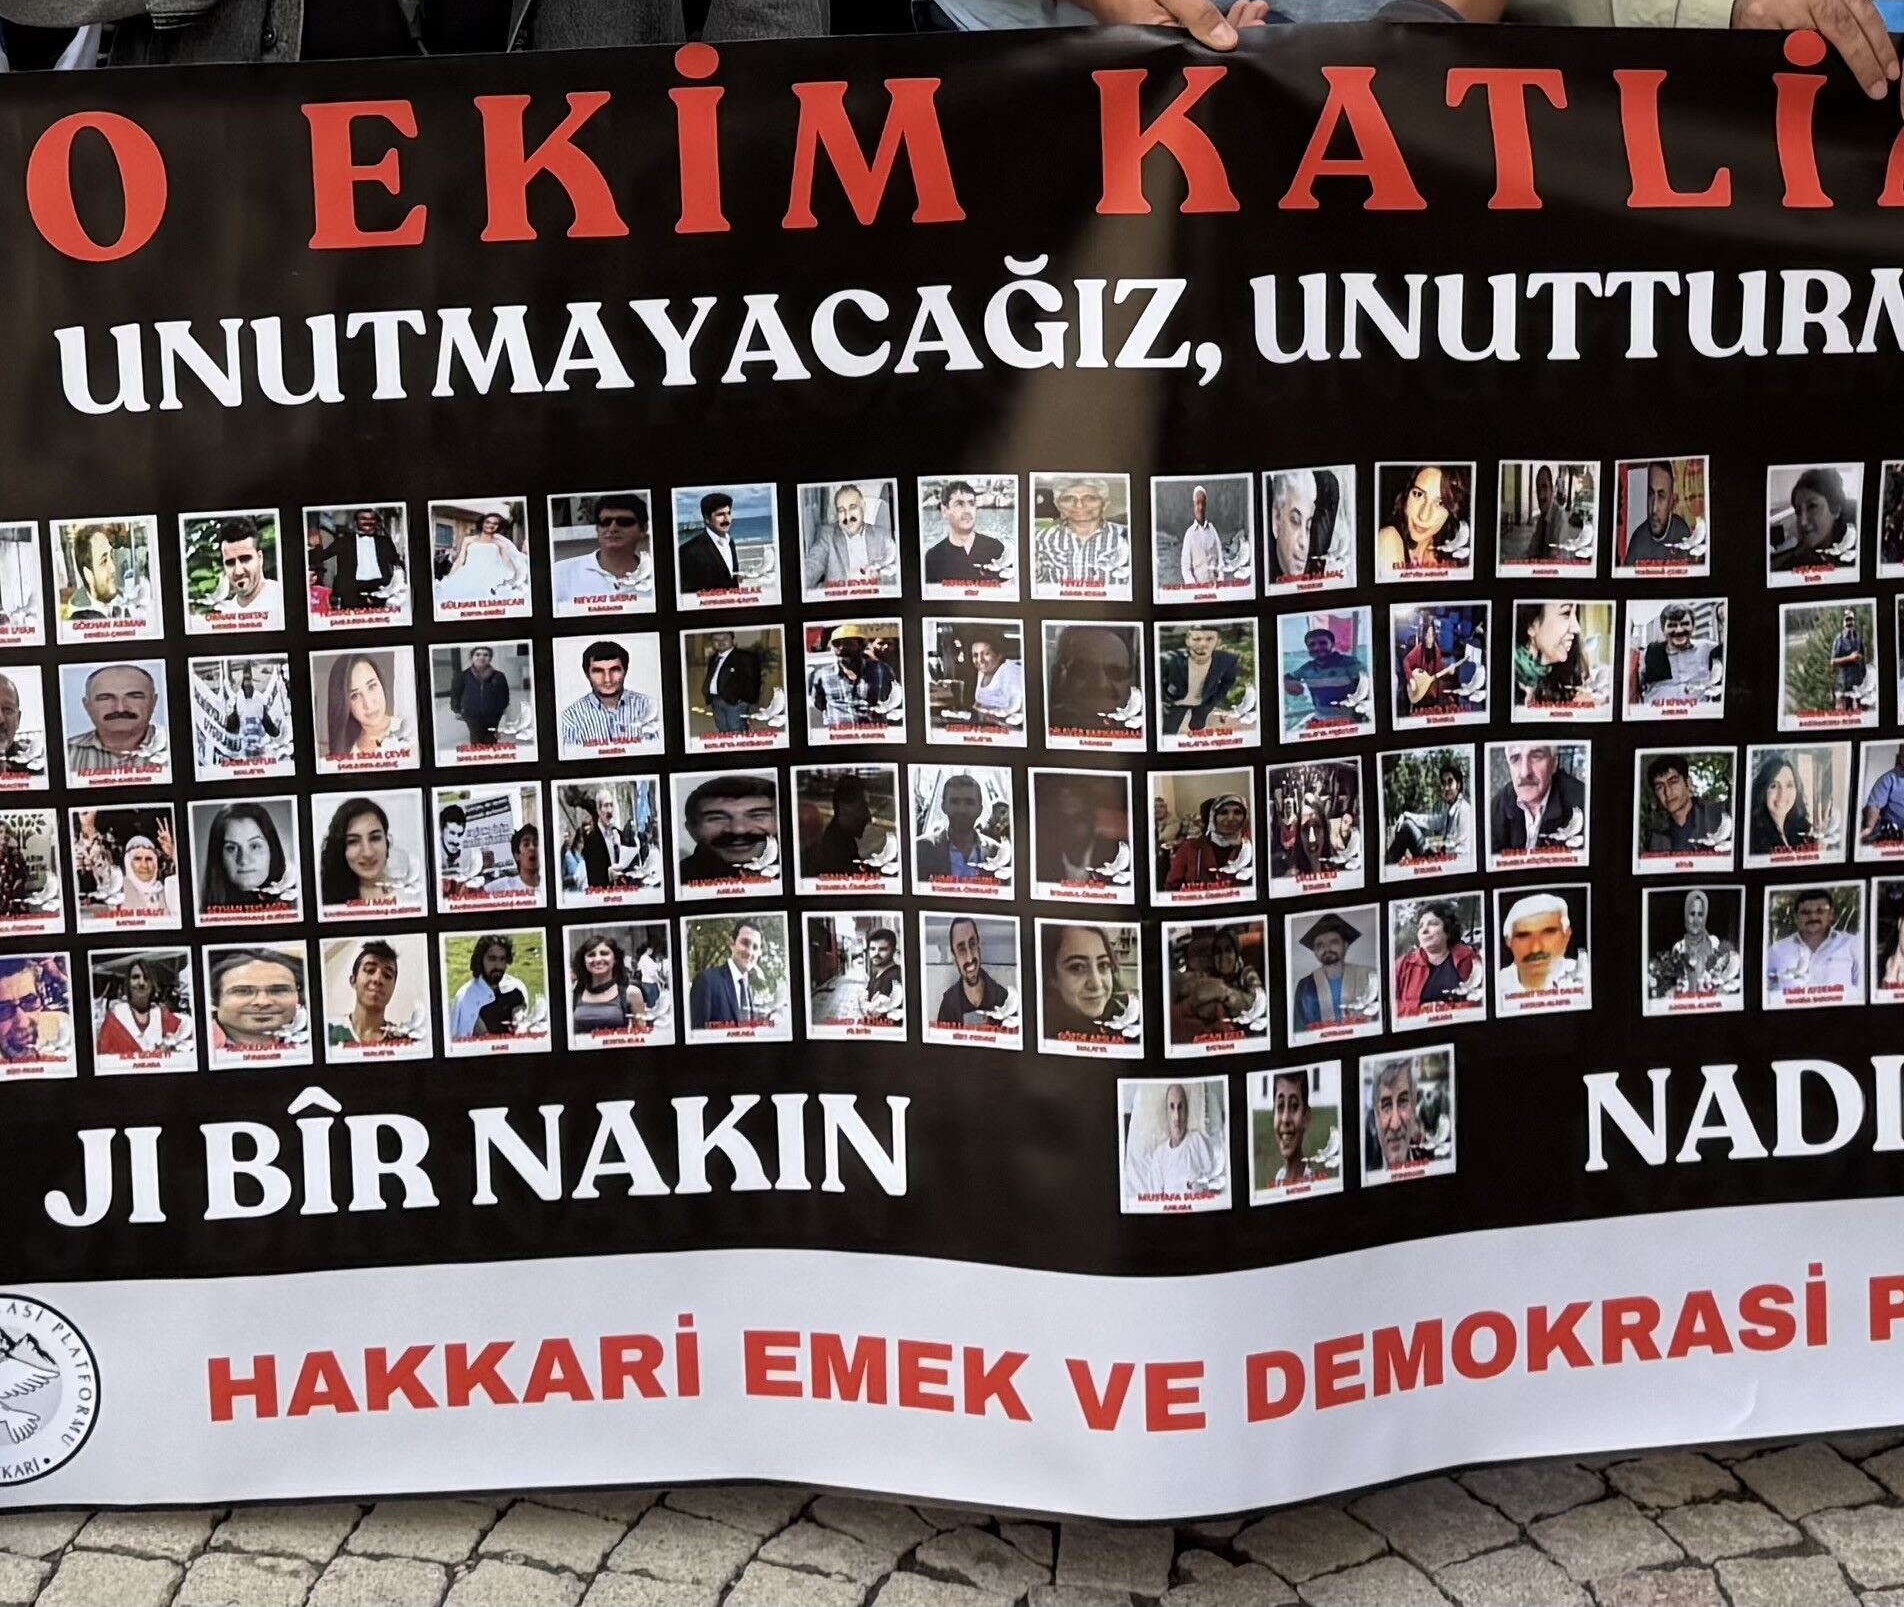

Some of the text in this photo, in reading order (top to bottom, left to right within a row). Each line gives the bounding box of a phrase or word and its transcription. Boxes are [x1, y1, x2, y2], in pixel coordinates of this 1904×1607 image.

[302, 41, 966, 250] EKİM
[54, 252, 1222, 416] UNUTMAYACAĞIZ,
[45, 1086, 912, 1228] JI BÎR NAKIN
[50, 1322, 93, 1448] PLATFORMU
[207, 1314, 699, 1422] HAKKARİ
[742, 1329, 1033, 1422] EMEK
[1064, 1357, 1206, 1436] VE
[1243, 1263, 1827, 1424] DEMOKRASİ
